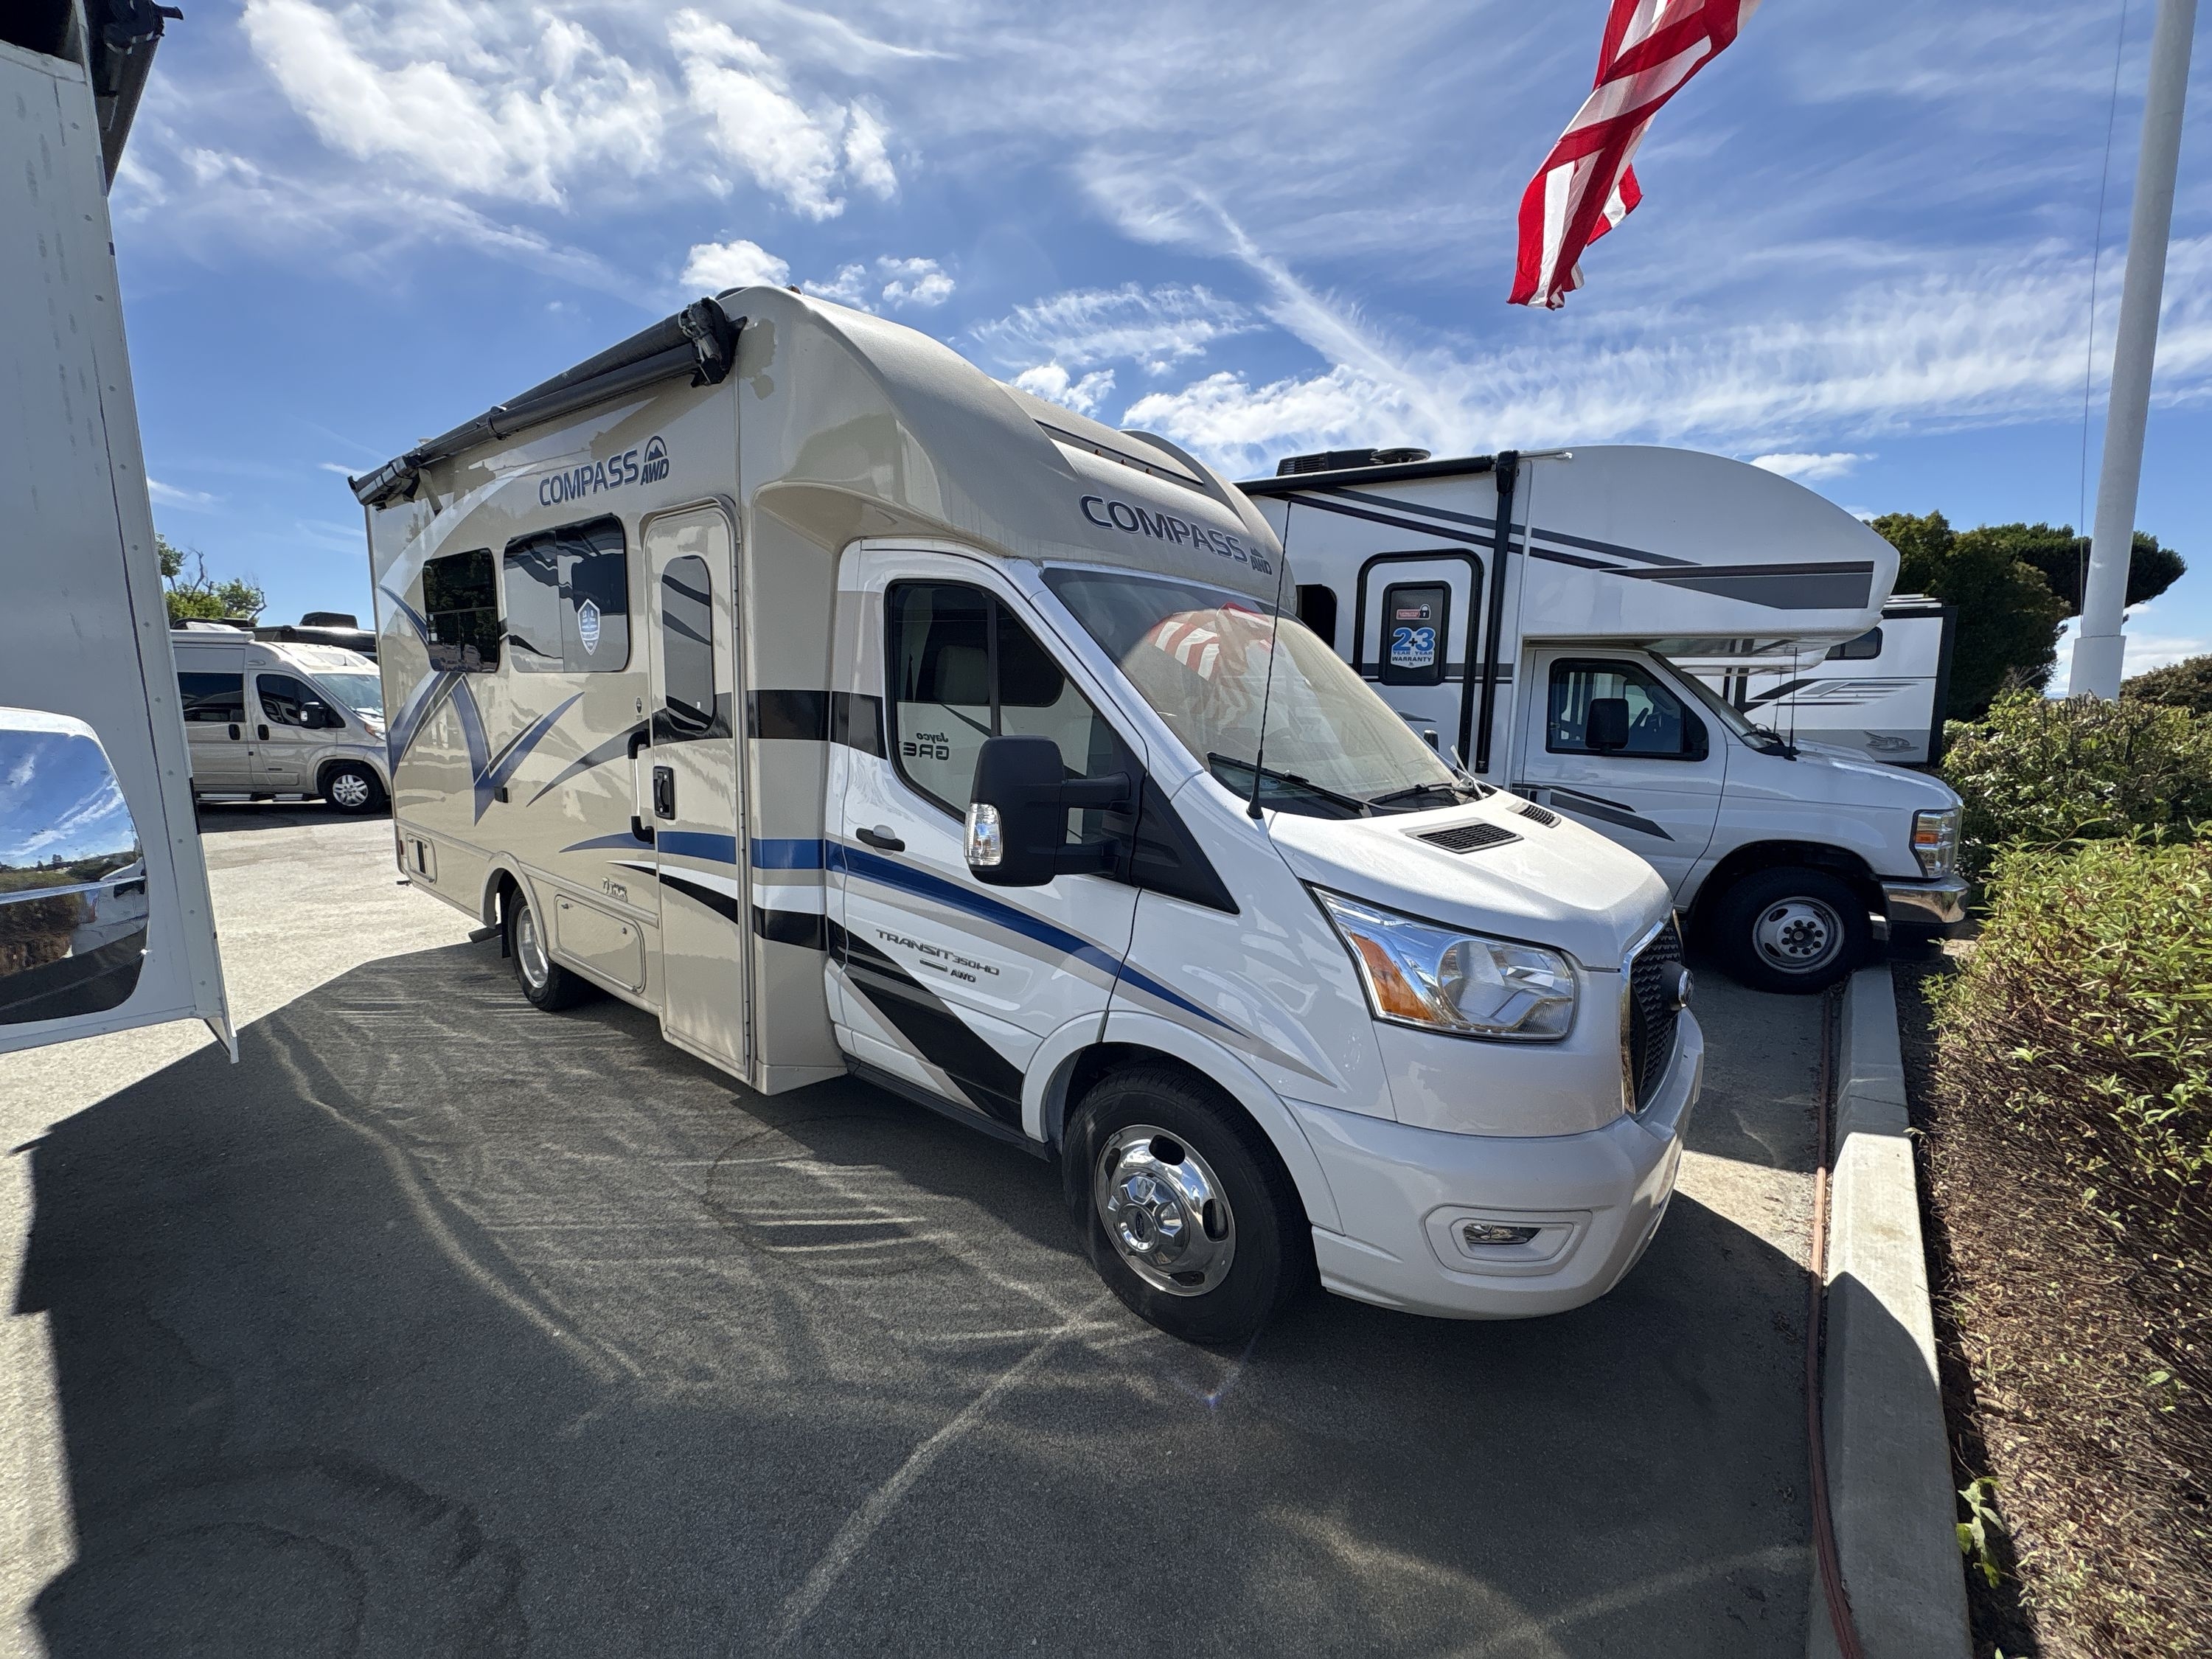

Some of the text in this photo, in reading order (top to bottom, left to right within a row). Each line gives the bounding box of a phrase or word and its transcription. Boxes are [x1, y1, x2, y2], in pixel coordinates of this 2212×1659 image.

[539, 449, 669, 507] COMPASS AWD
[1079, 495, 1272, 575] COMPASS AWD
[950, 969, 976, 983] AWD
